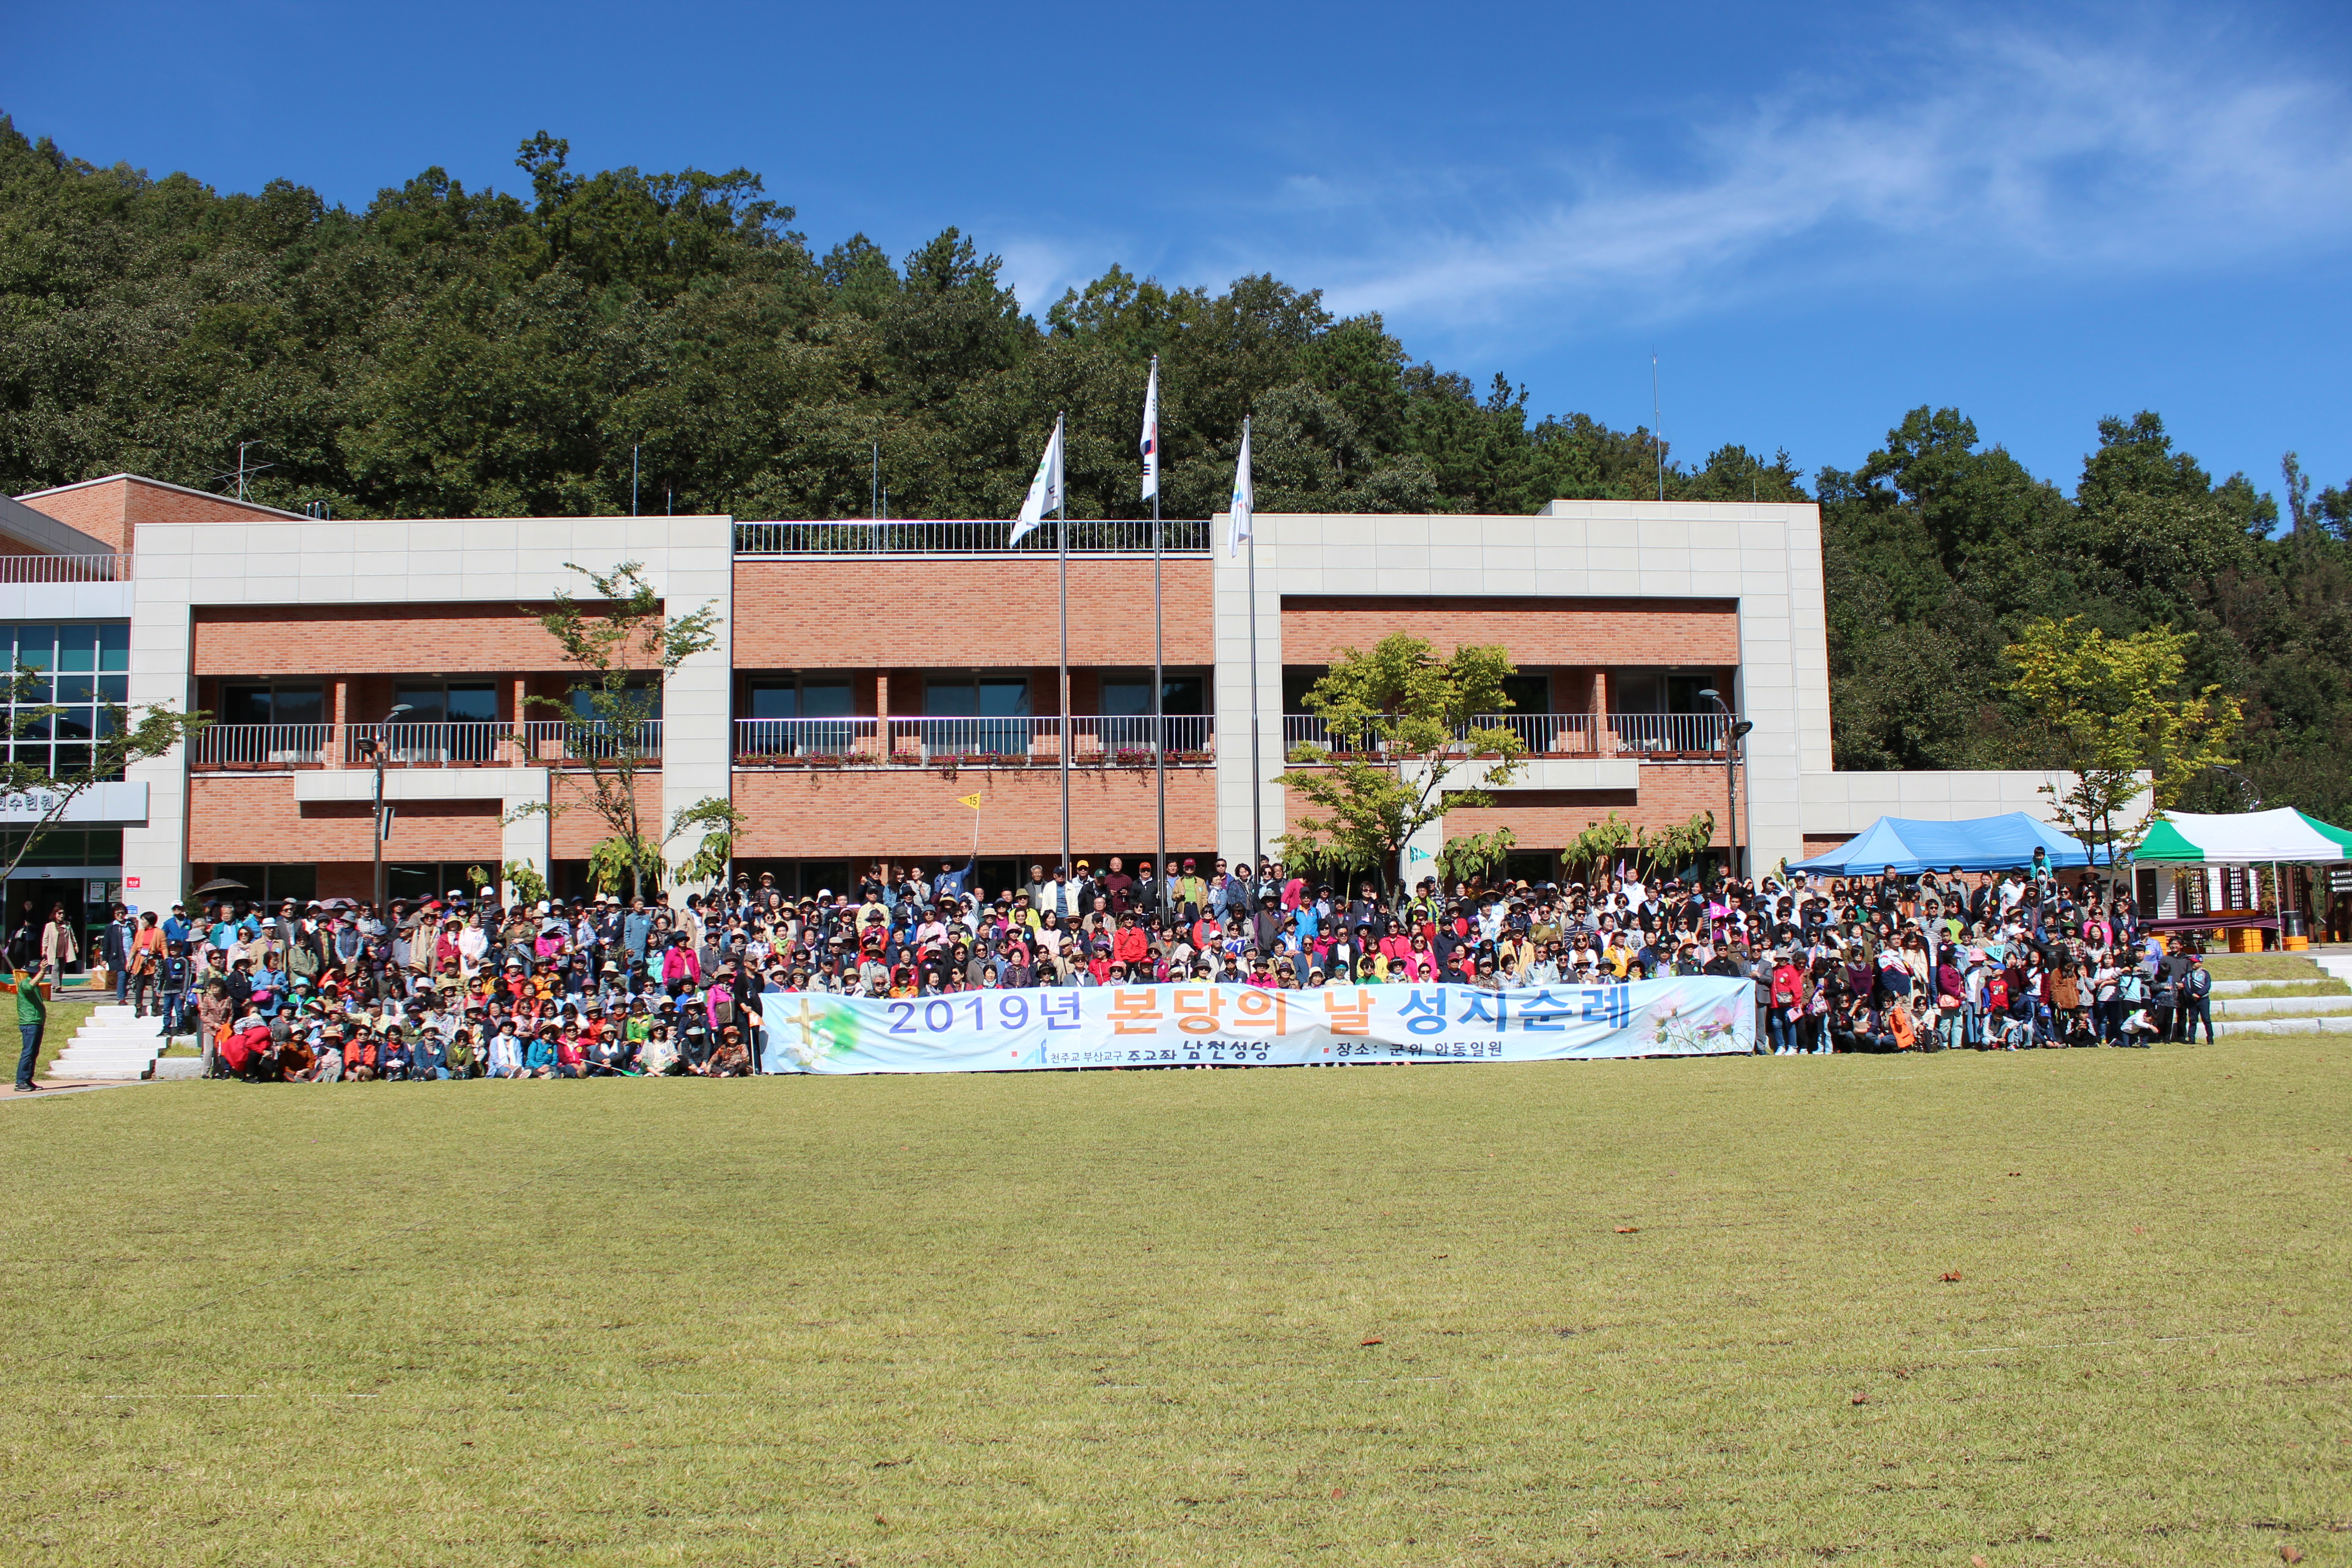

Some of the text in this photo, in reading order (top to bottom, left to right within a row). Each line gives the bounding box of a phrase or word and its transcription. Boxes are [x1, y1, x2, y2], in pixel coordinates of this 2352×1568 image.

[969, 796, 977, 805] 15
[1711, 906, 1721, 915] 12
[564, 941, 573, 952] 5
[1236, 942, 1242, 953] 1
[1993, 947, 2001, 956] 19
[696, 991, 704, 1002] 8
[887, 985, 1629, 1036] 2019년 본당의 날 성지순례
[749, 1013, 758, 1024] 14
[1051, 1040, 1271, 1063] 천주교 부산교구 주교좌 남천성당
[1336, 1041, 1502, 1057] 장소: 군위 안동일원
